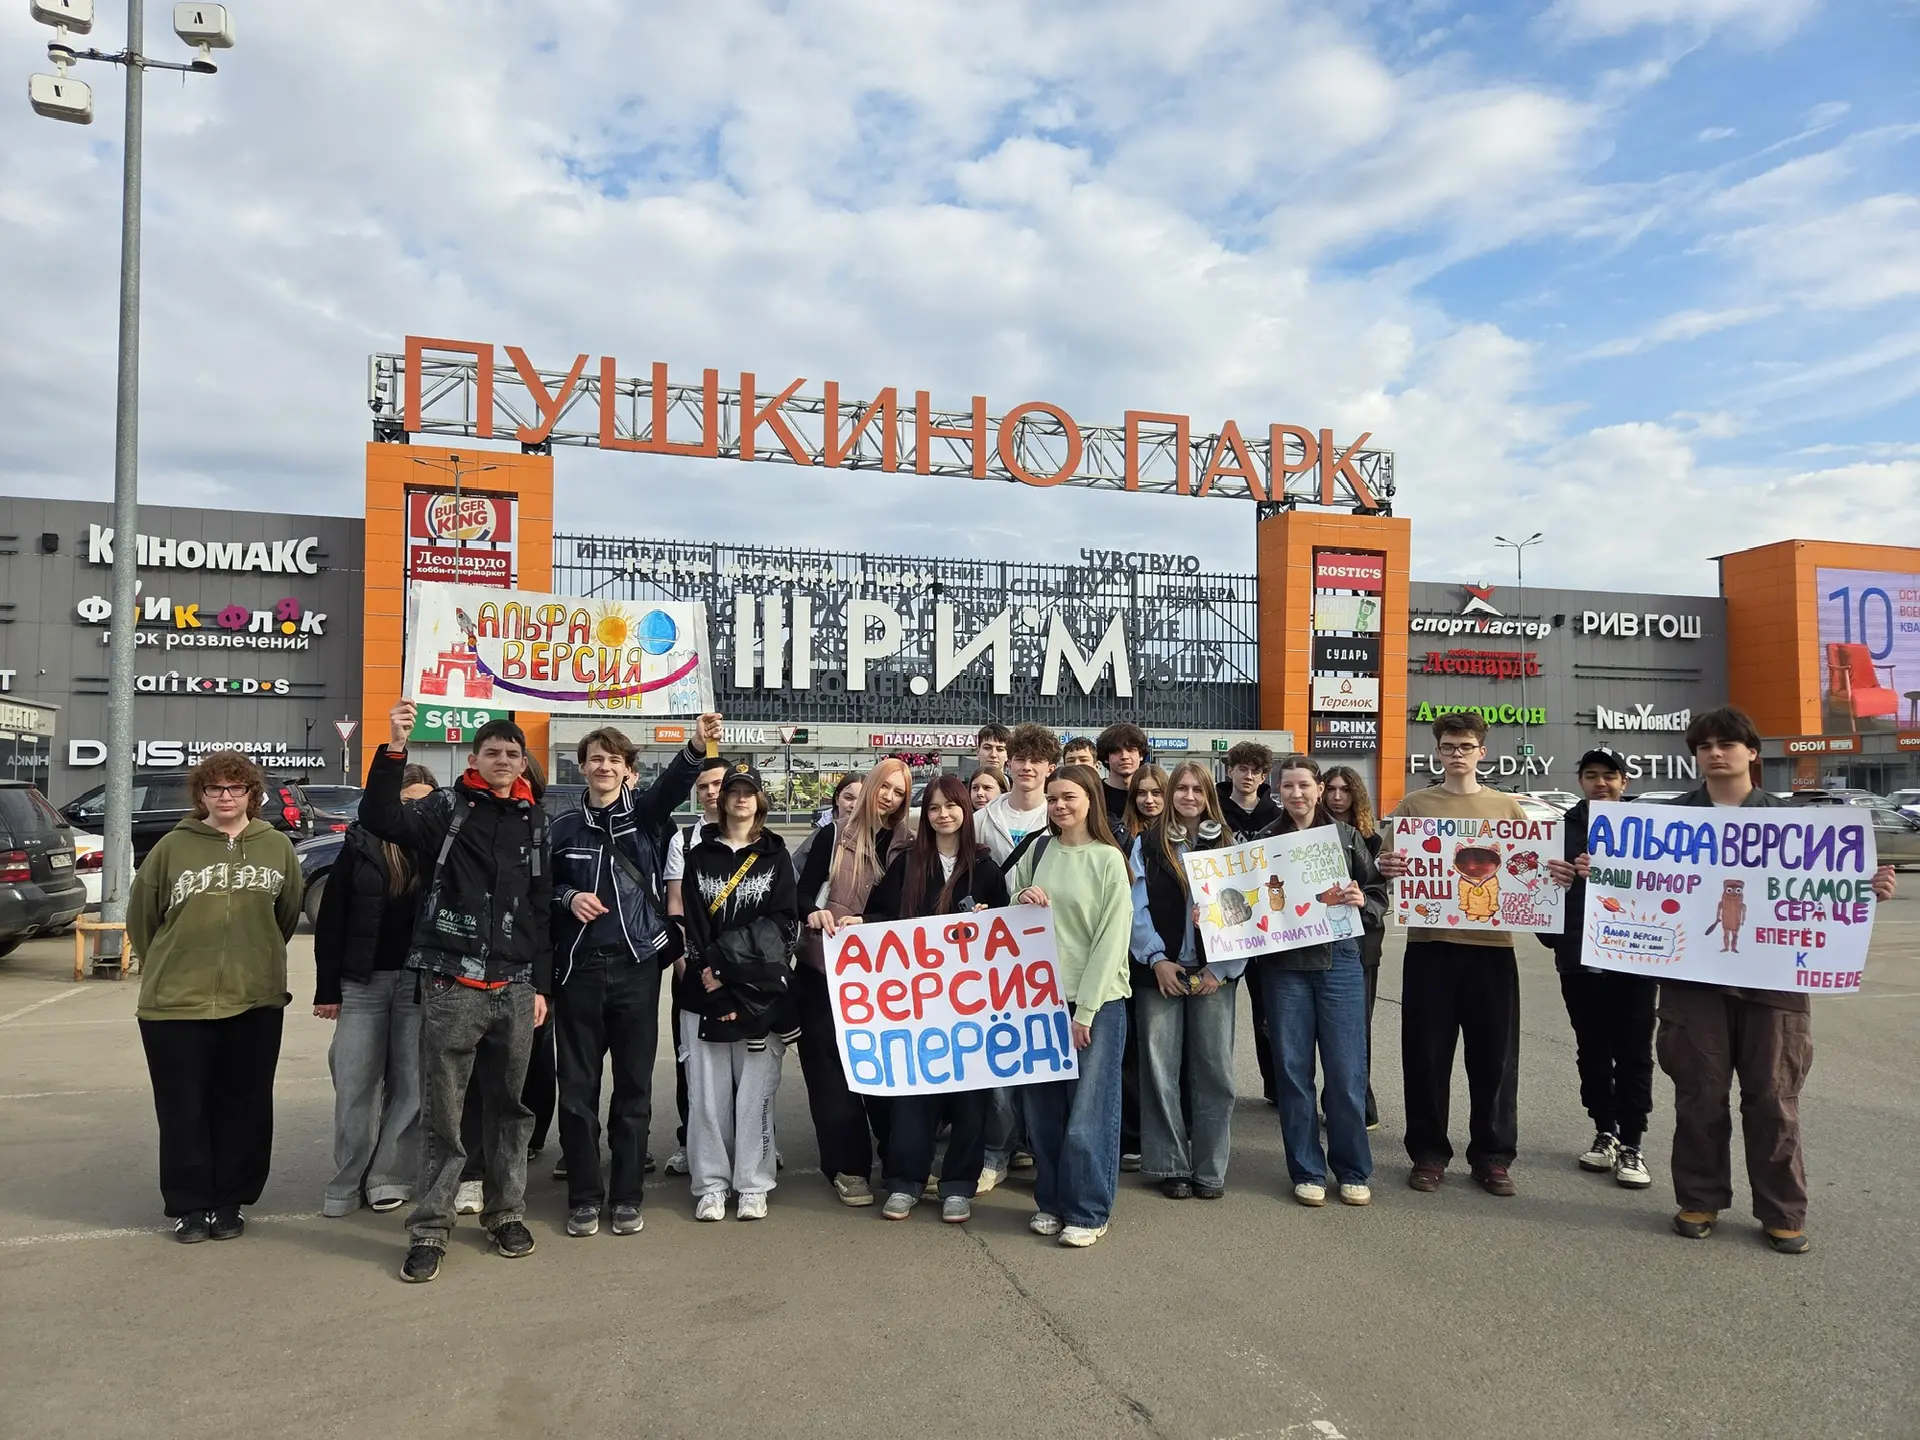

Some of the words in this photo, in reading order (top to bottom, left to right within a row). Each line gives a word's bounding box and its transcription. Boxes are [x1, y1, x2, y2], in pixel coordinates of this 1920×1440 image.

[404, 335, 1082, 487] ПУШКИНО
[1125, 409, 1379, 509] ПАРК
[435, 500, 486, 519] BURGER
[437, 511, 488, 534] KING
[416, 551, 507, 570] Леонардо
[1080, 547, 1200, 573] ЧУВСТВУЮ
[624, 556, 712, 576] ТЕАТР
[722, 562, 837, 584] МУЗЫКИ
[876, 569, 935, 588] ШОУ
[1318, 566, 1382, 579] ROSTIC'S
[1157, 585, 1236, 600] ПРЕМЬЕРА
[477, 600, 591, 645] АЛЬФА
[1411, 617, 1551, 639] спортмастер
[1583, 611, 1638, 636] РИВ
[1644, 614, 1701, 638] ГОШ
[1829, 587, 1893, 660] 10
[166, 633, 309, 650] развлечений
[502, 641, 642, 684] ВЕРСИЯ
[1326, 648, 1368, 660] СУДАРЬ
[1423, 651, 1539, 680] Леонардо
[587, 683, 643, 710] КВН
[1320, 695, 1373, 709] Теремок
[425, 710, 490, 728] sela
[1330, 721, 1377, 733] DRINX
[450, 731, 456, 740] 5
[885, 734, 932, 746] ПАНДА
[937, 735, 979, 746] ТАБА
[1789, 741, 1826, 752] ОБОИ
[69, 739, 184, 767] DS
[188, 741, 272, 754] ЦИФРОВАЯ
[276, 742, 287, 753] И
[260, 756, 326, 768] ТЕХНИКА
[1617, 752, 1698, 779] STIN
[1396, 818, 1557, 841] АРСЮША-GOAT
[1588, 814, 1718, 866] АЛЬФА
[1721, 822, 1865, 874] ВЕРСИЯ
[1188, 844, 1268, 881] ВАНЯ
[1402, 857, 1443, 878] КВН
[1400, 880, 1453, 900] НАШ
[1589, 867, 1633, 890] ВАШ
[1636, 870, 1702, 894] ЮМОР
[1767, 876, 1780, 901] В
[1785, 876, 1873, 903] САМОЕ
[1796, 952, 1807, 968] К
